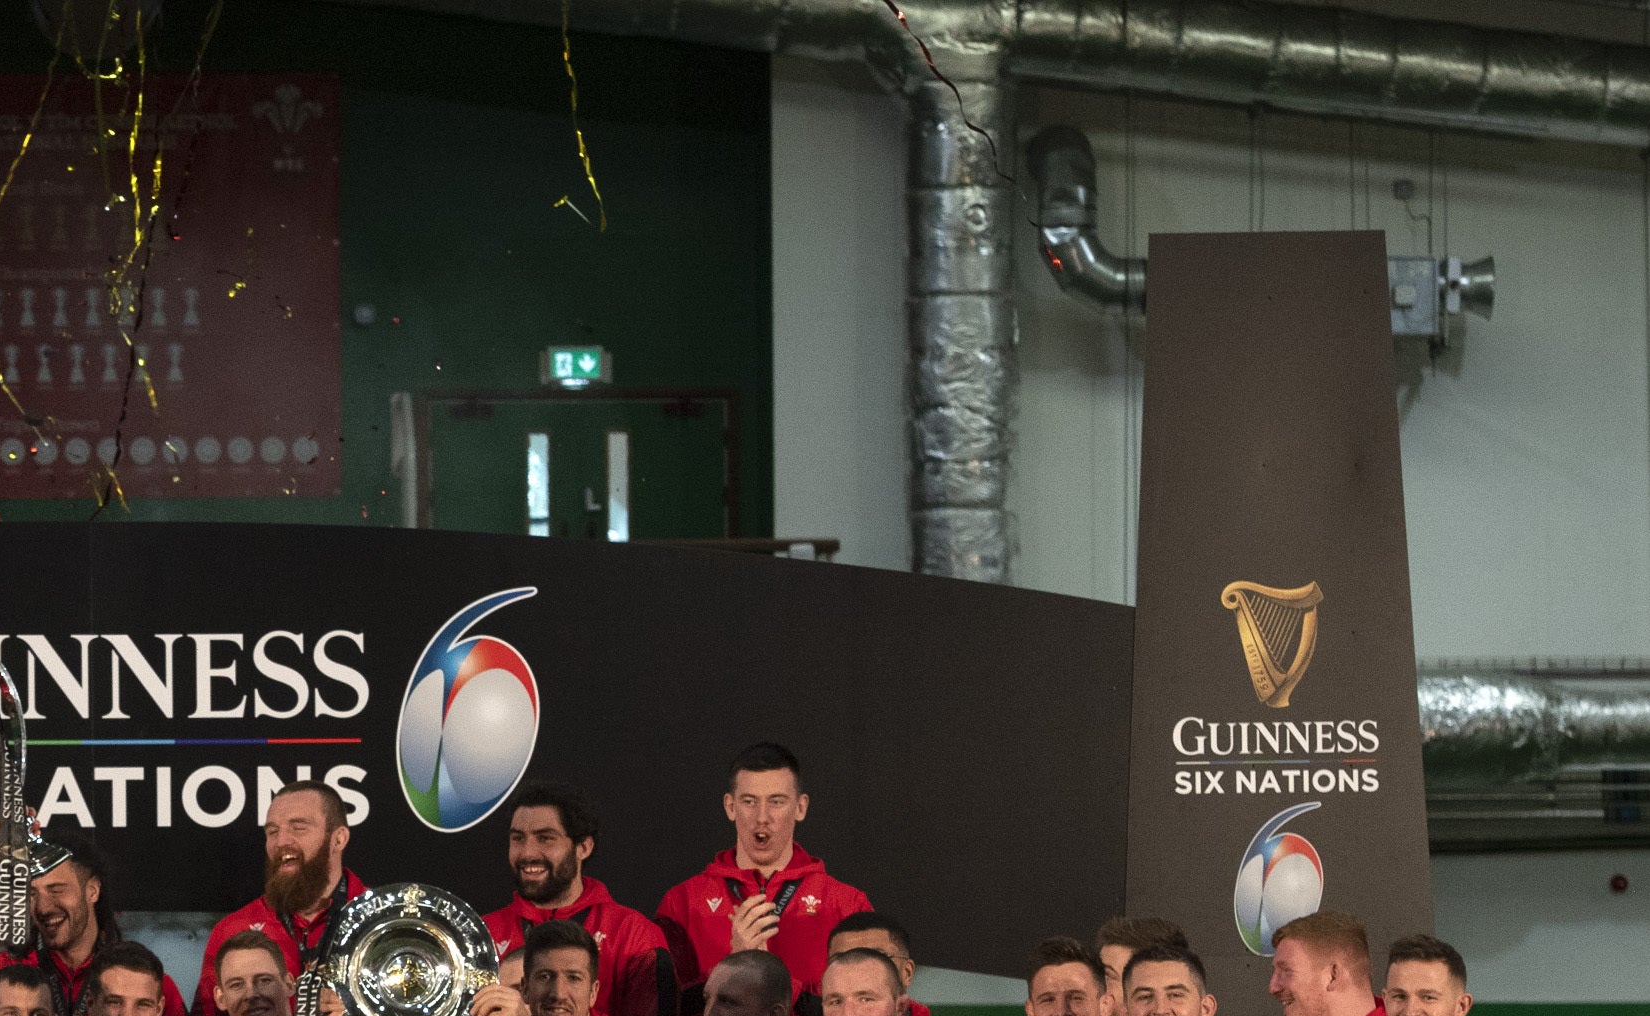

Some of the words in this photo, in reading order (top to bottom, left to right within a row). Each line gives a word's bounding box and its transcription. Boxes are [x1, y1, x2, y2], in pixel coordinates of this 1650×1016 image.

[1172, 716, 1381, 756] GUINNESS
[1175, 769, 1226, 796] SIX
[1236, 768, 1382, 795] NATIONS
[12, 863, 29, 945] GUINNESS
